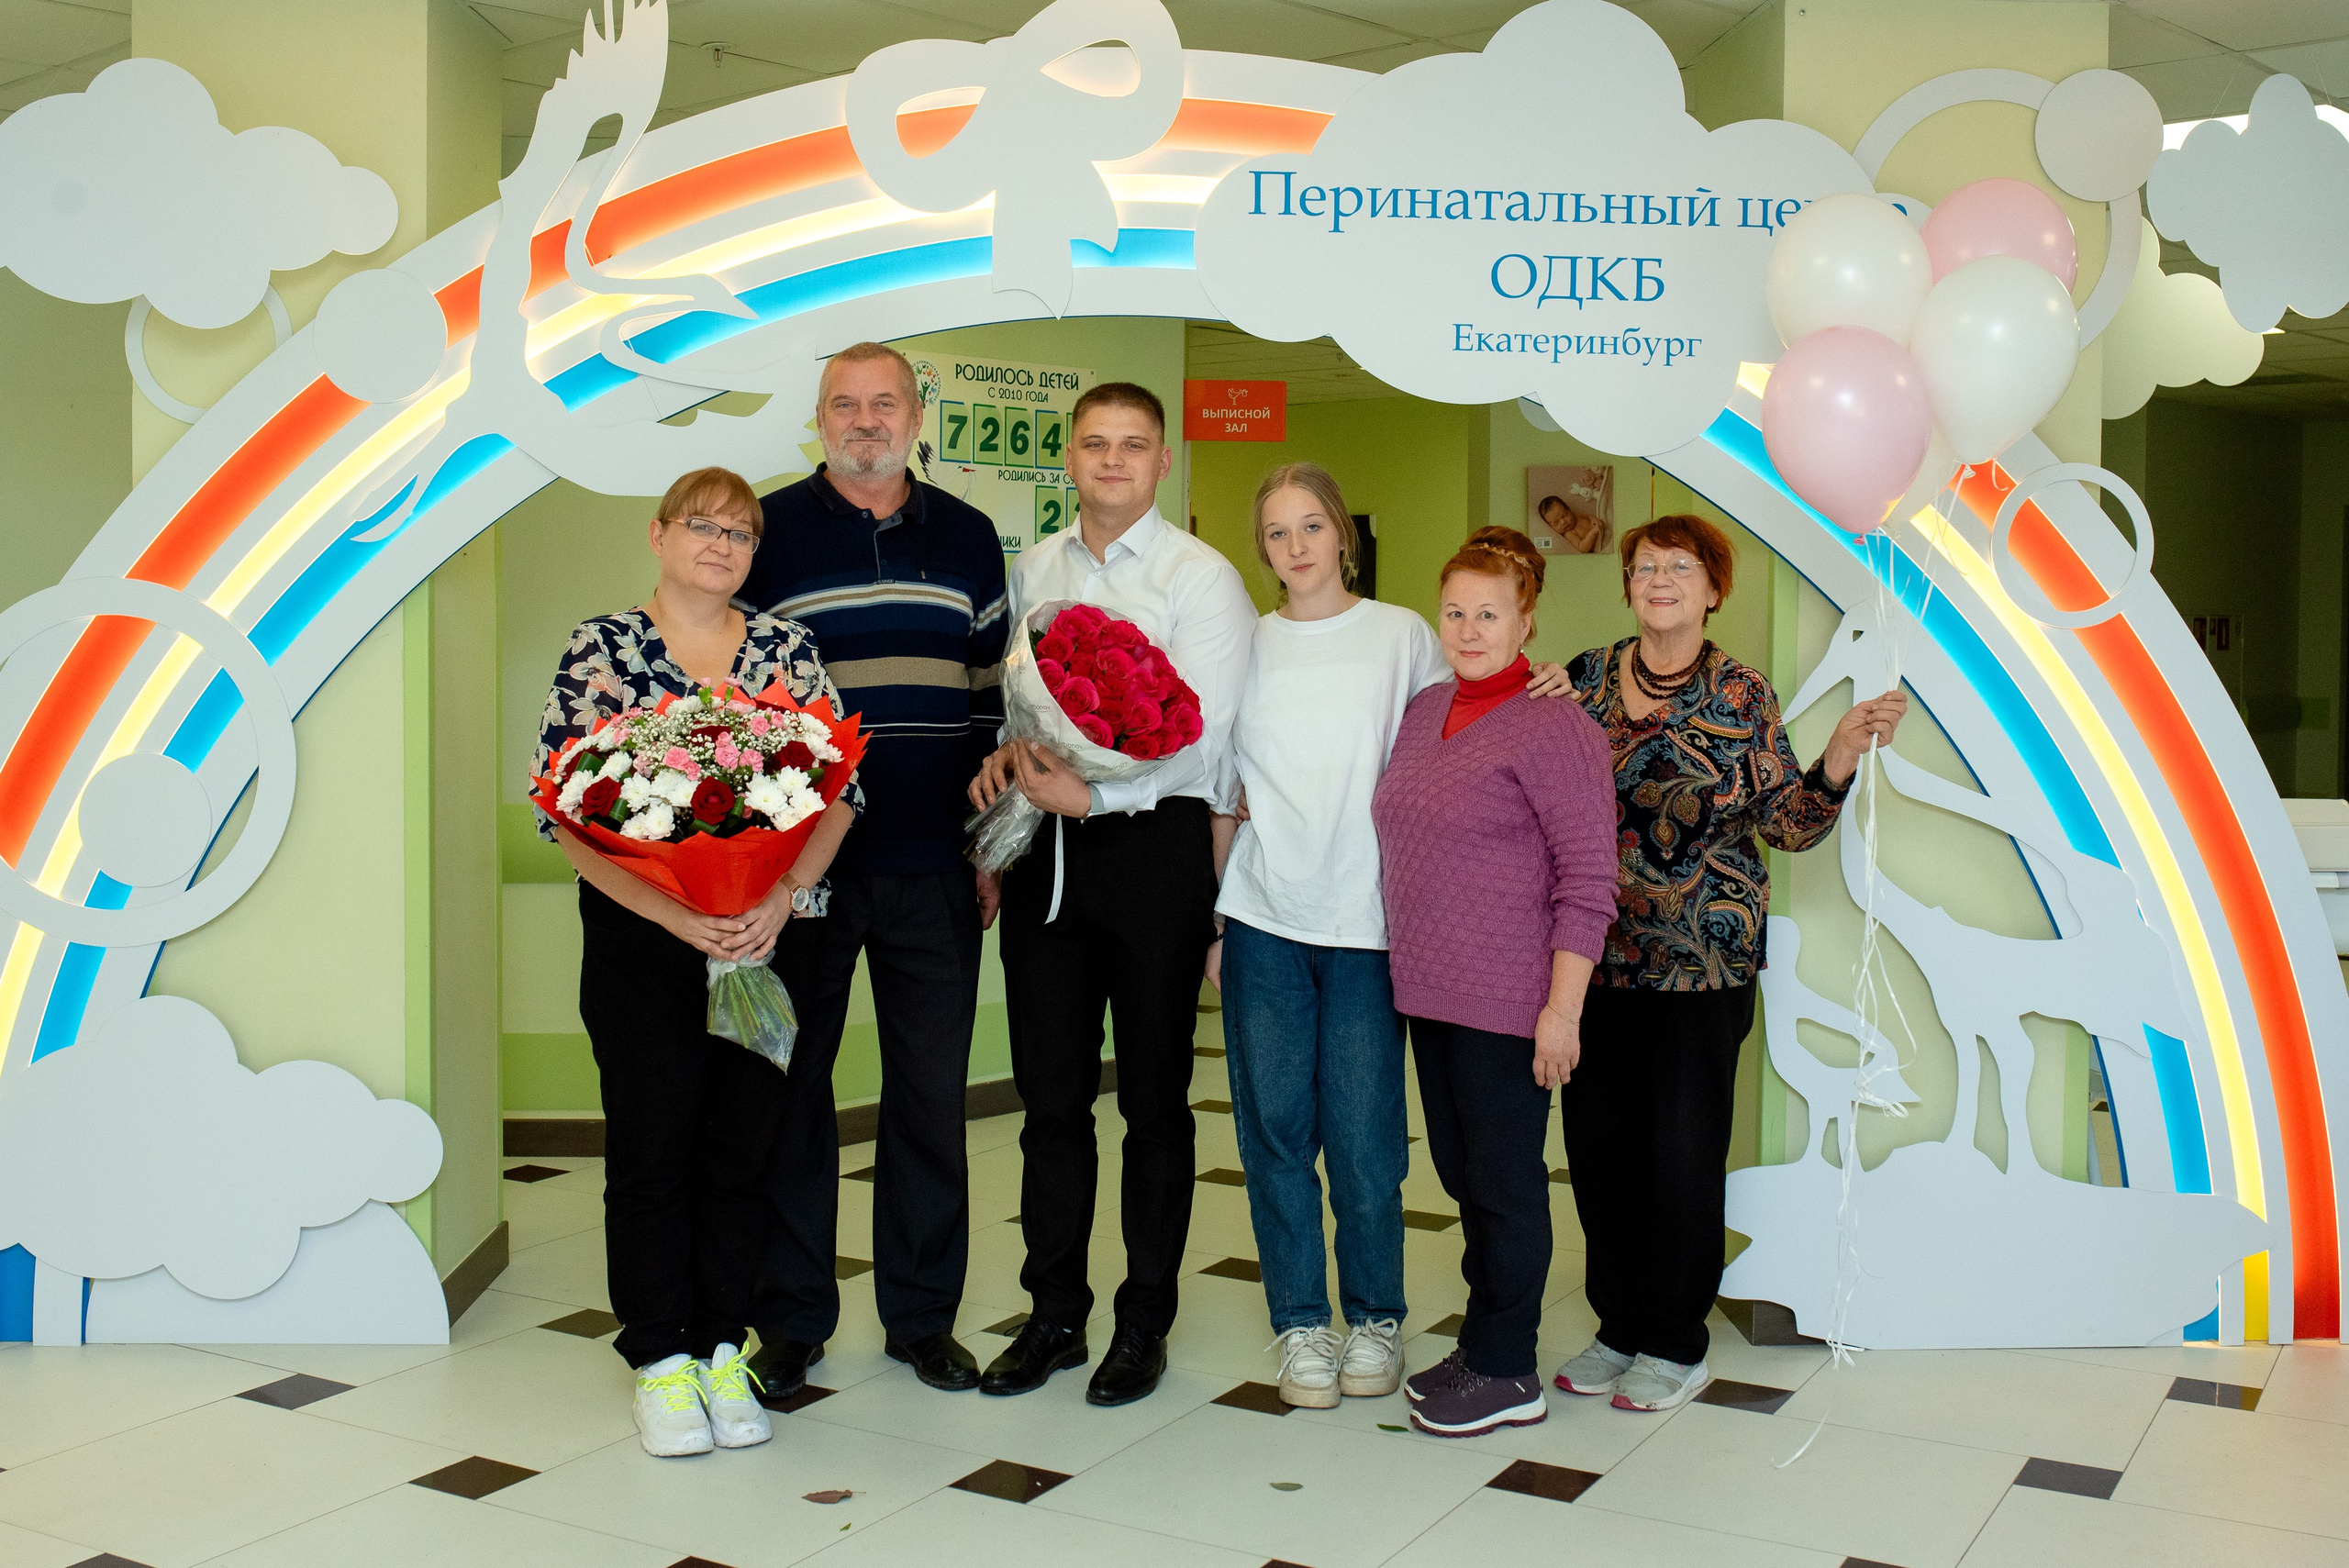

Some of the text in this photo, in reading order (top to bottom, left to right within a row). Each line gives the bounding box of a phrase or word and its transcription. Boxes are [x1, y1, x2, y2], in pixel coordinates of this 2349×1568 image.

[1248, 170, 1721, 233] Перинатальный
[1490, 253, 1665, 311] ОДКБ
[1452, 323, 1703, 367] Екатеринбург
[955, 363, 1034, 386] РОДИЛОСЬ
[1038, 372, 1080, 391] ДЕТЕЙ
[998, 387, 1023, 401] 2010
[1025, 390, 1049, 403] ГОДА
[1202, 406, 1271, 419] ВЫПИСНОЙ
[1224, 422, 1248, 433] ЗАЛ
[997, 469, 1047, 484] РОДИЛИСЬ
[1049, 472, 1060, 484] ЗА
